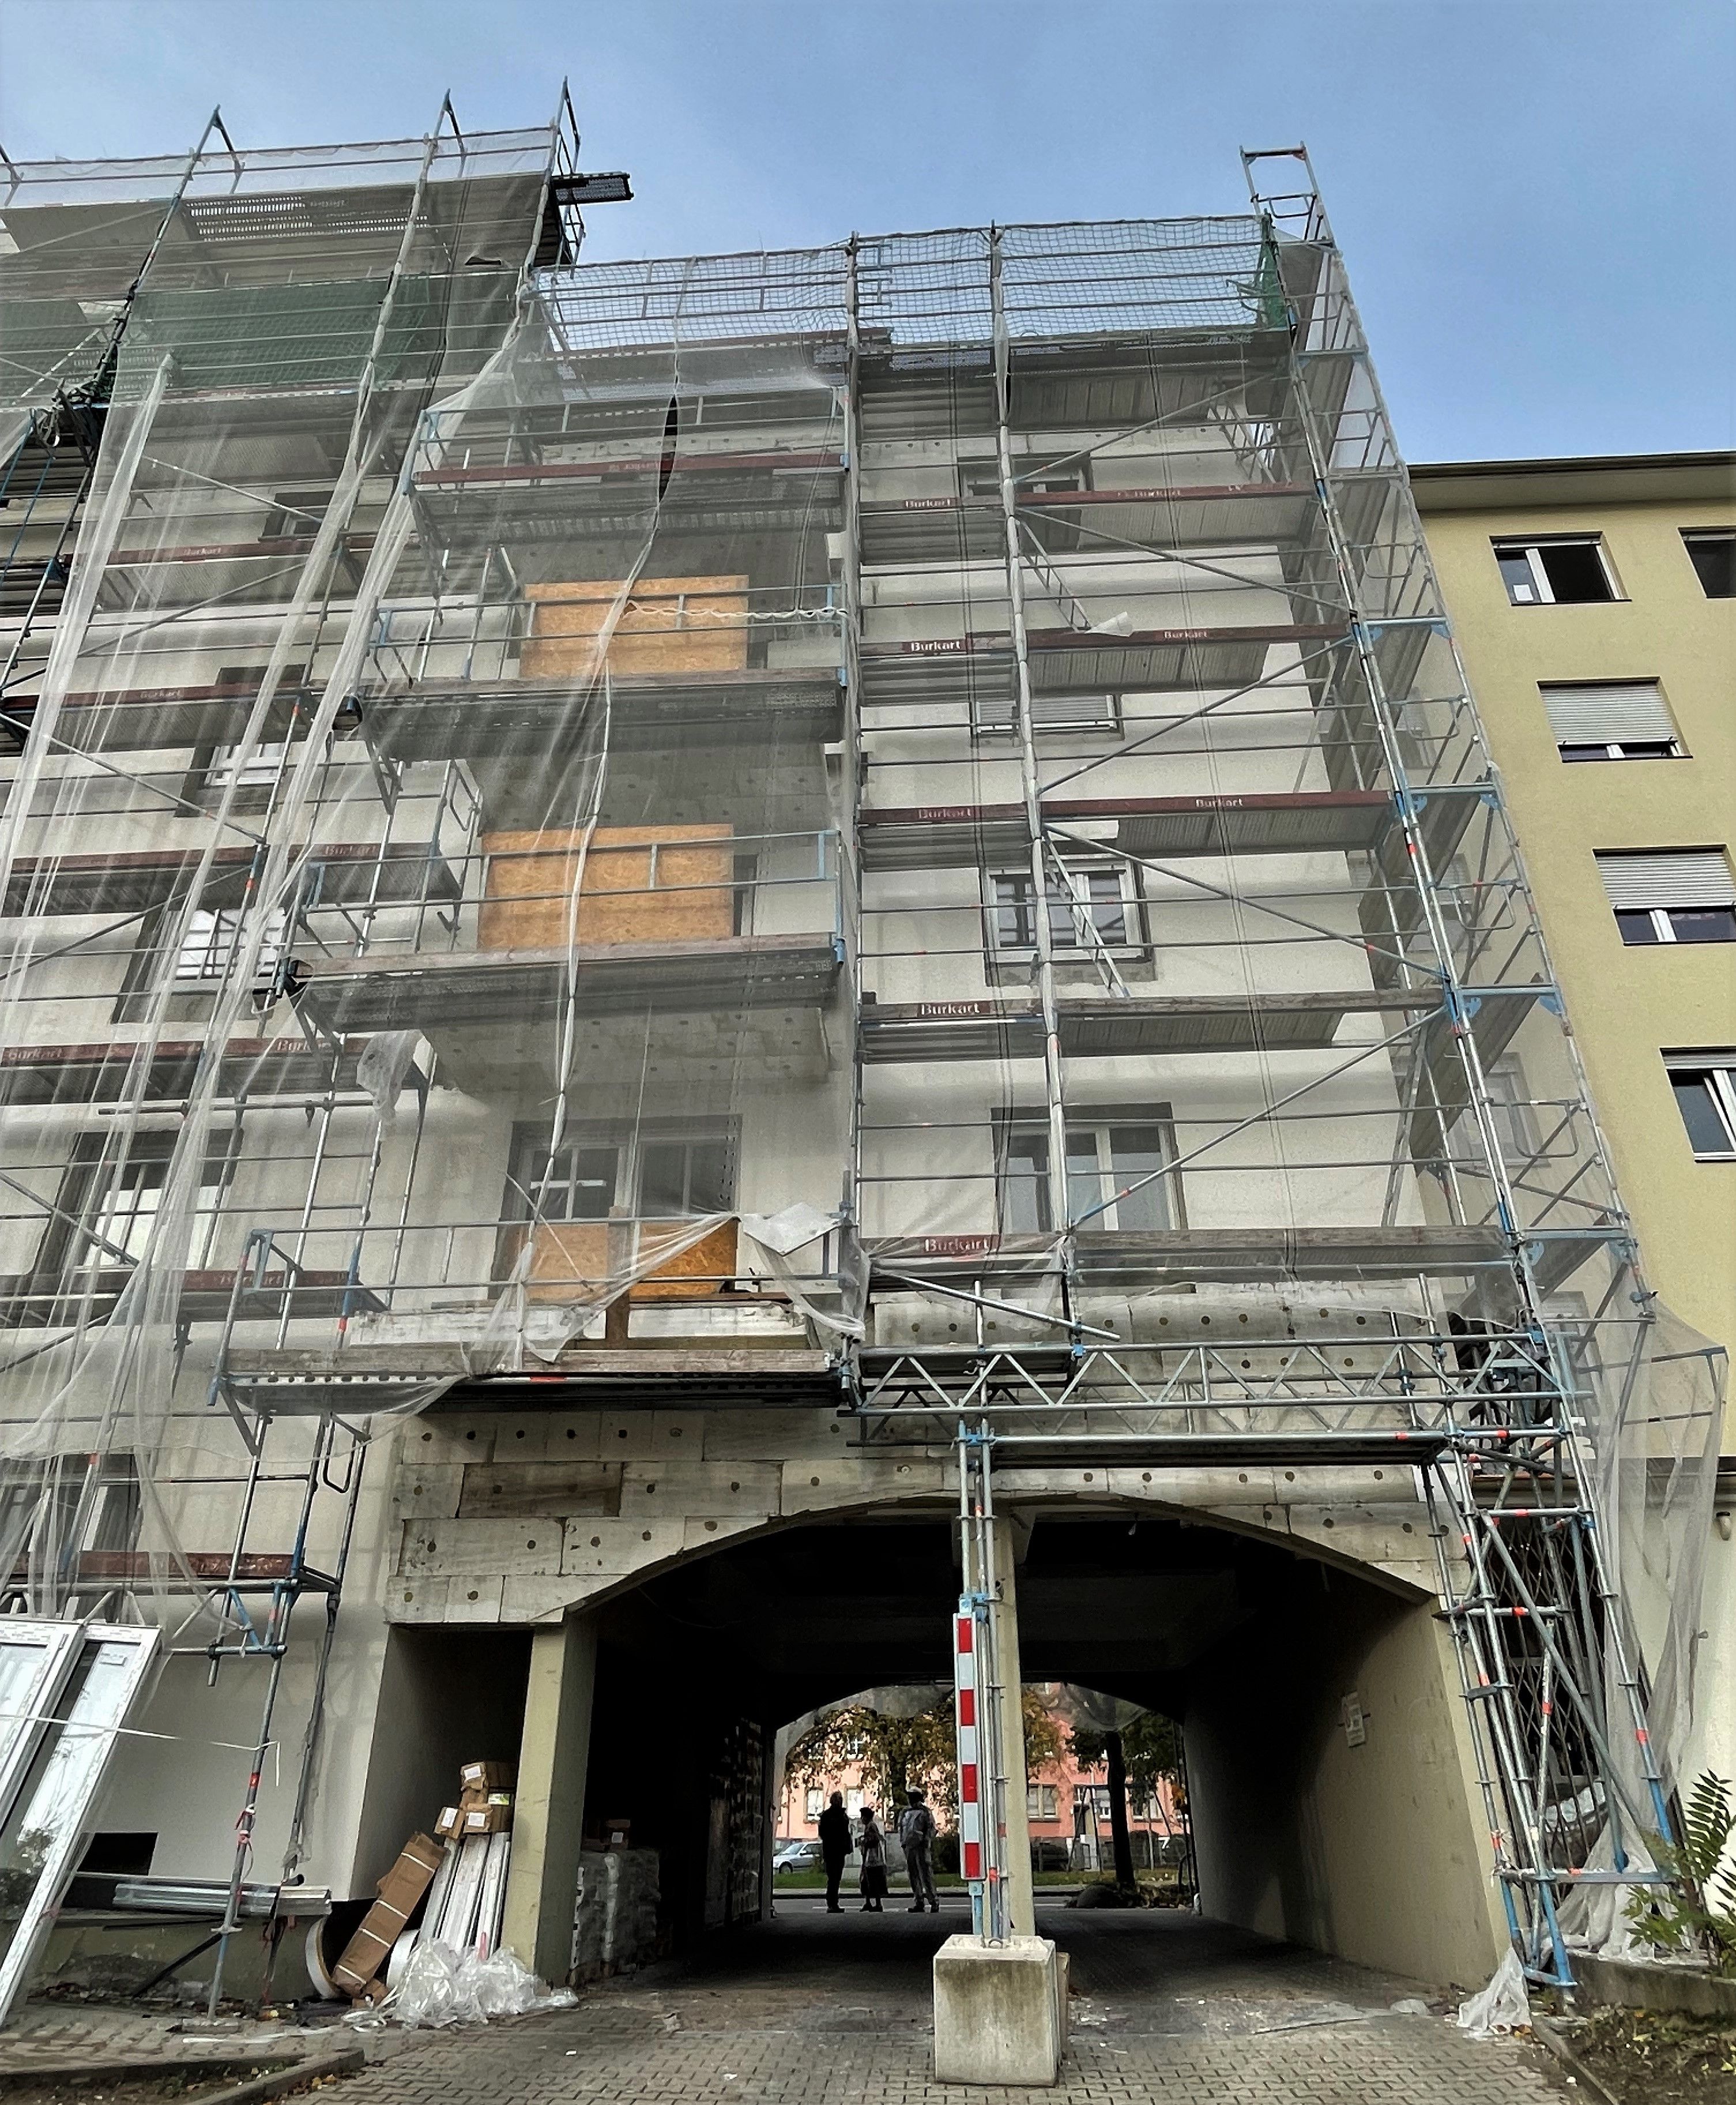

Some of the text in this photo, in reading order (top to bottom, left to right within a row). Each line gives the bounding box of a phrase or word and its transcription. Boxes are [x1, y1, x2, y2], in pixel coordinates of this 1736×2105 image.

[1165, 631, 1207, 639] Burkart
[911, 640, 961, 652] Burkart
[918, 807, 971, 819] Burkart
[921, 1002, 980, 1015] Burkart
[925, 1238, 988, 1251] Burkart
